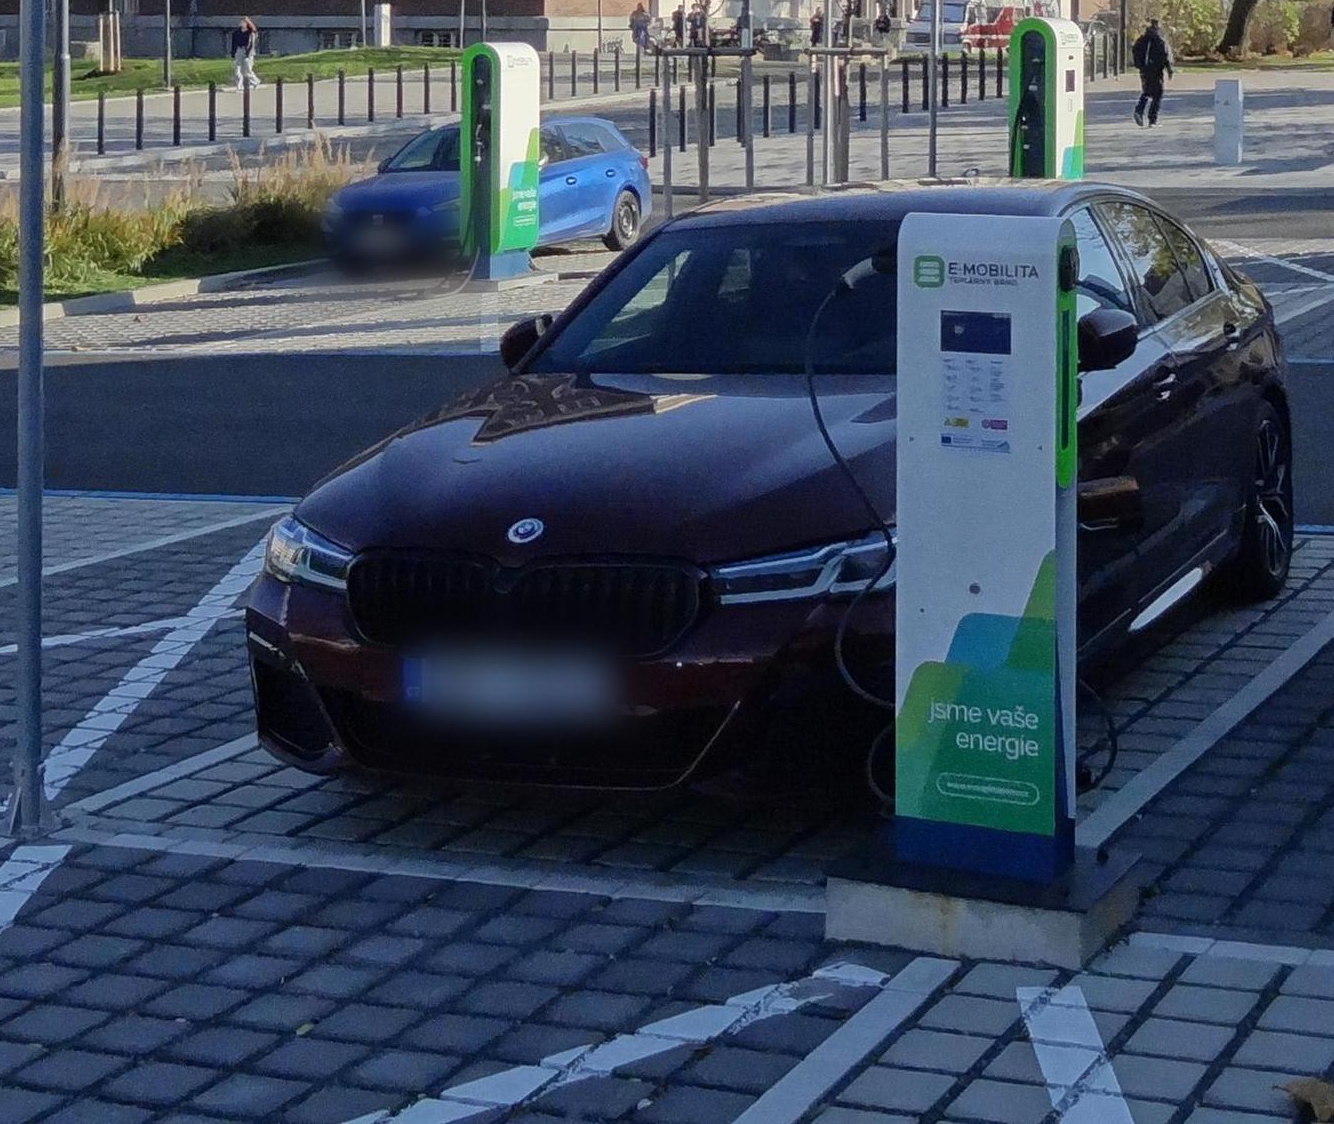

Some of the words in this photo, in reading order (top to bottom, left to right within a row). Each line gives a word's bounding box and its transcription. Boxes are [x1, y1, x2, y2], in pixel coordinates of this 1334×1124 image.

[927, 697, 982, 724] jsme
[986, 705, 1039, 730] vaše
[955, 732, 1039, 760] energie
